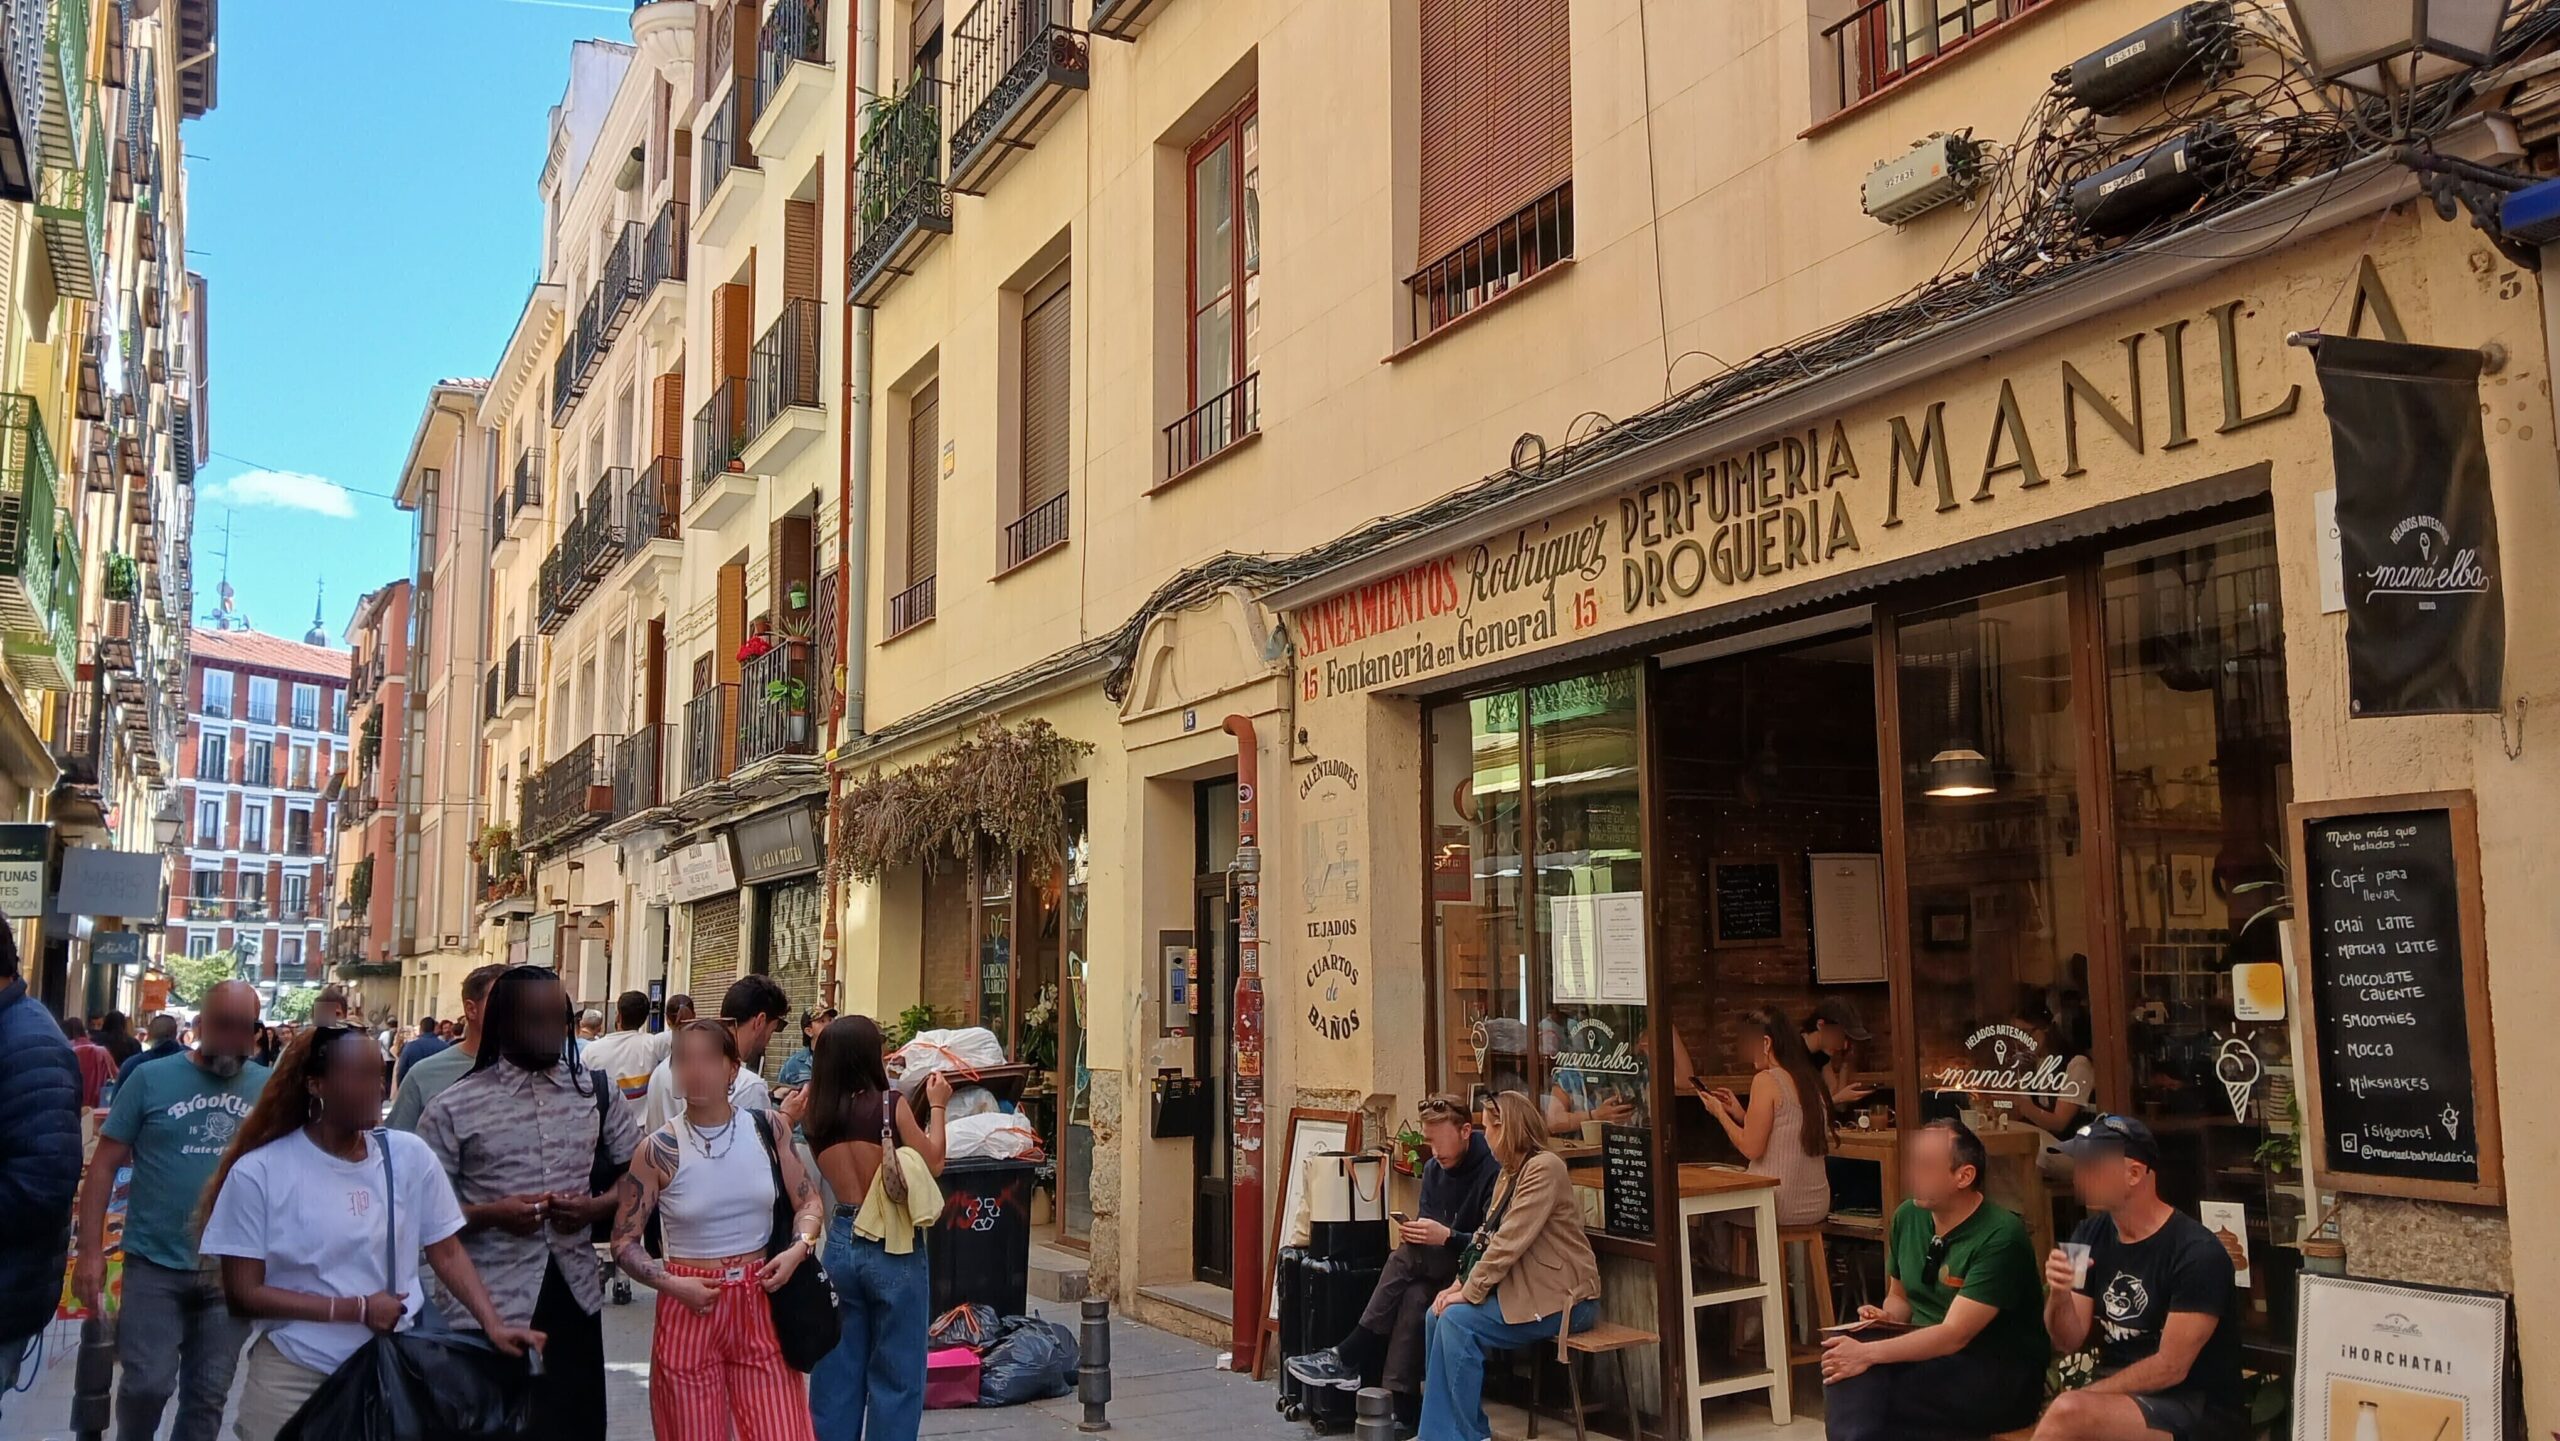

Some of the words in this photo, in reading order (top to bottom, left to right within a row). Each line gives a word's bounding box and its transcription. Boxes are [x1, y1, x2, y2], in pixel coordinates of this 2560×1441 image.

[1880, 253, 2407, 528] MANILA
[1619, 418, 1860, 553] PERFUMERIA
[2389, 516, 2418, 545] HELADOS
[2418, 514, 2450, 547] ARTESANOS
[1622, 490, 1861, 613] DROGUERIA
[1299, 553, 1458, 660] SANEAMIENTOS
[1302, 666, 1319, 702] 15
[1437, 643, 1455, 668] en
[1457, 593, 1558, 660] General
[1573, 587, 1598, 631] 15
[1299, 758, 1360, 801] CALENTADORES
[2366, 826, 2390, 839] más
[1306, 918, 1358, 939] TEJADOS
[982, 963, 1008, 979] LORENA
[984, 978, 1007, 994] MARCO
[1306, 953, 1360, 988] CUARTOS
[1325, 977, 1339, 1002] de
[1307, 1003, 1361, 1042] BAÑOS
[1964, 1025, 1996, 1050] HELADOS
[1995, 1024, 2038, 1051] ARTESANOS
[181, 1144, 211, 1154] State
[212, 1145, 223, 1156] of
[2341, 1344, 2451, 1375] ¡HORCHATA!
